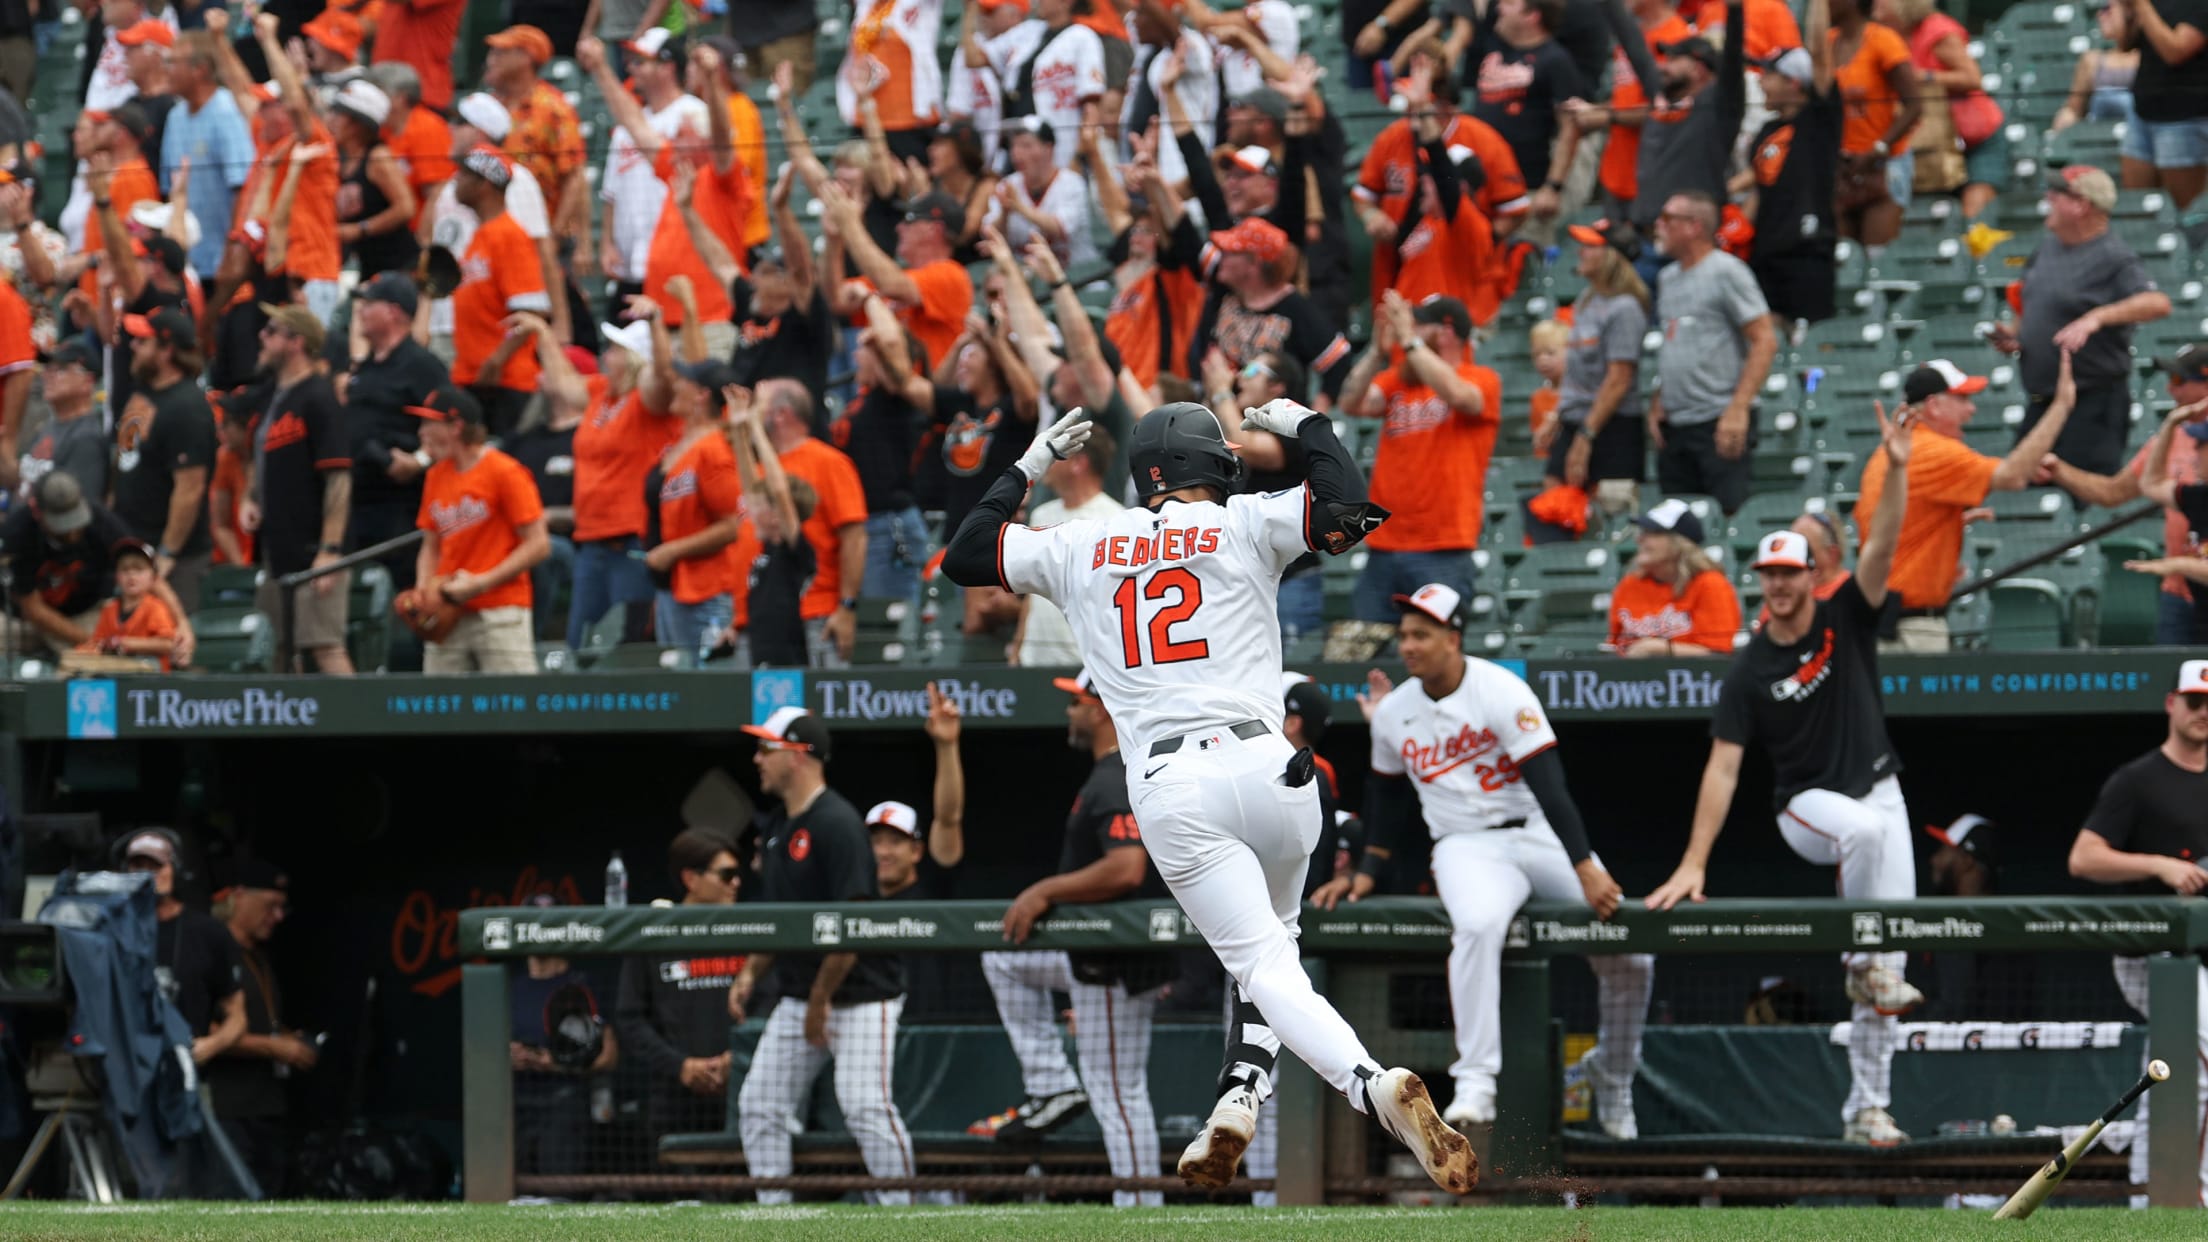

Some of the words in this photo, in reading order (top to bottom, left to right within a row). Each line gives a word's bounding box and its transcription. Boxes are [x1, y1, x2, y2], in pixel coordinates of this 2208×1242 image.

[1092, 526, 1221, 571] BEAVERS
[1113, 567, 1209, 669] 12
[388, 694, 462, 714] INVEST
[473, 694, 526, 712] WITH
[536, 692, 671, 712] CONFIDENCE
[1920, 675, 1980, 694] WITH
[1991, 672, 2139, 693] CONFIDENCE
[1402, 723, 1499, 783] Orioles
[1474, 752, 1522, 794] 29
